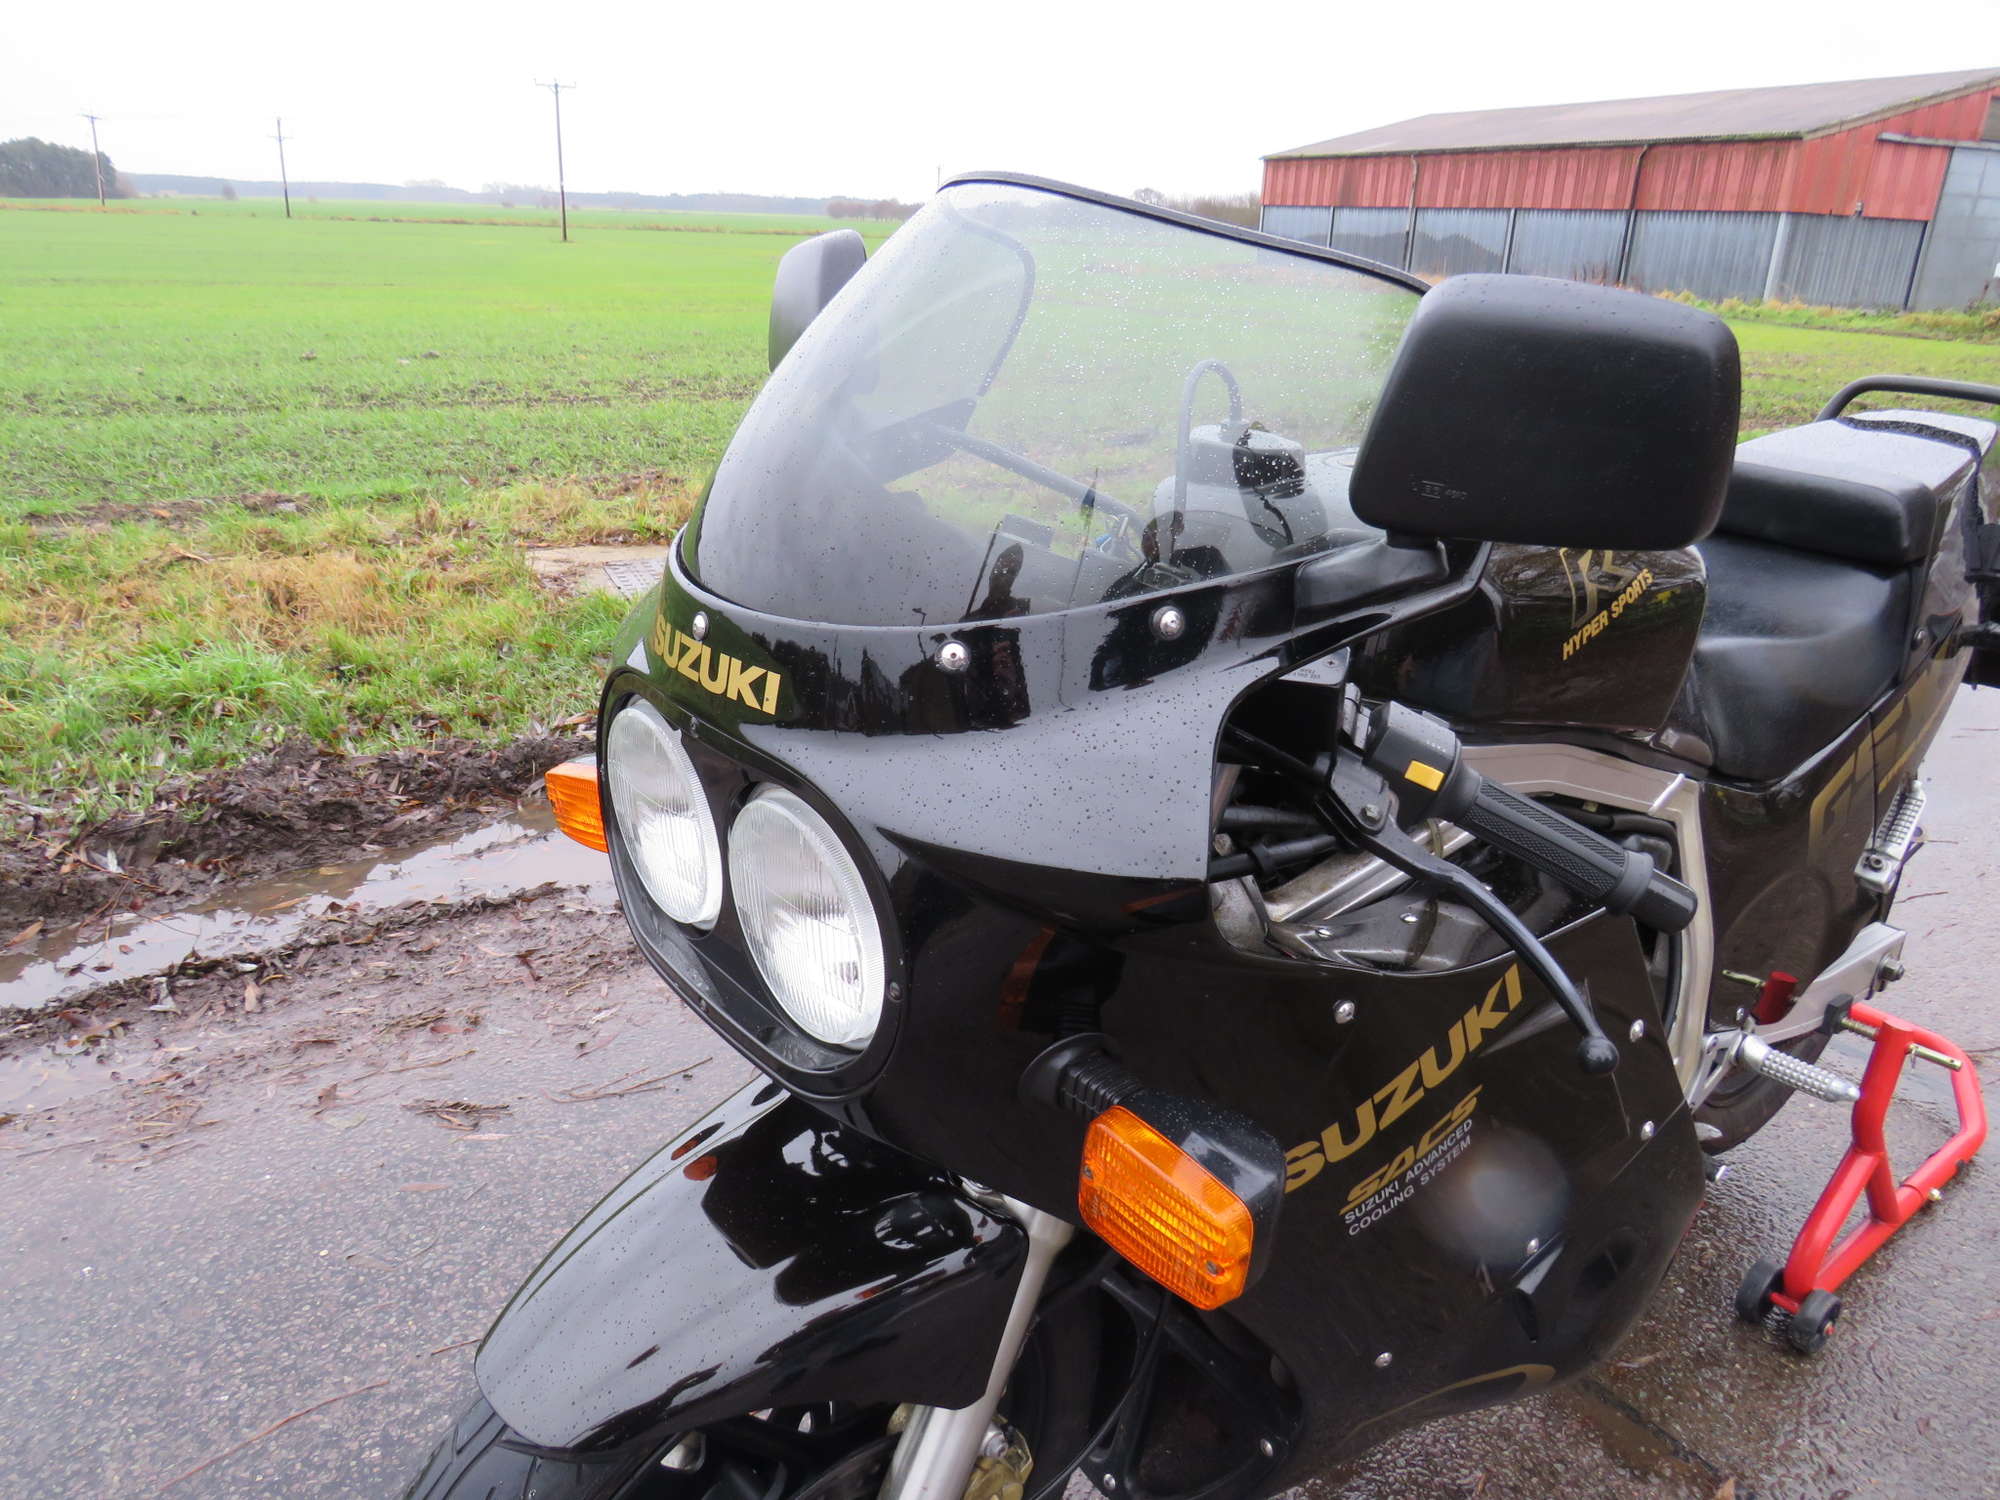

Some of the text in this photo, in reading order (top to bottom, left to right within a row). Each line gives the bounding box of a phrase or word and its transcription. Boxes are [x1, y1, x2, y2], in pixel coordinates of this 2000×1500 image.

[653, 614, 781, 715] SUZUKI
[1562, 610, 1609, 660] HYPER
[1611, 568, 1654, 618] SPORTS
[1284, 963, 1522, 1194] SUZUKI
[1339, 1084, 1483, 1215] SACS
[1345, 1118, 1473, 1224] SUZUKI ADVANCED
[1348, 1134, 1471, 1236] COOLING SYSTEM
